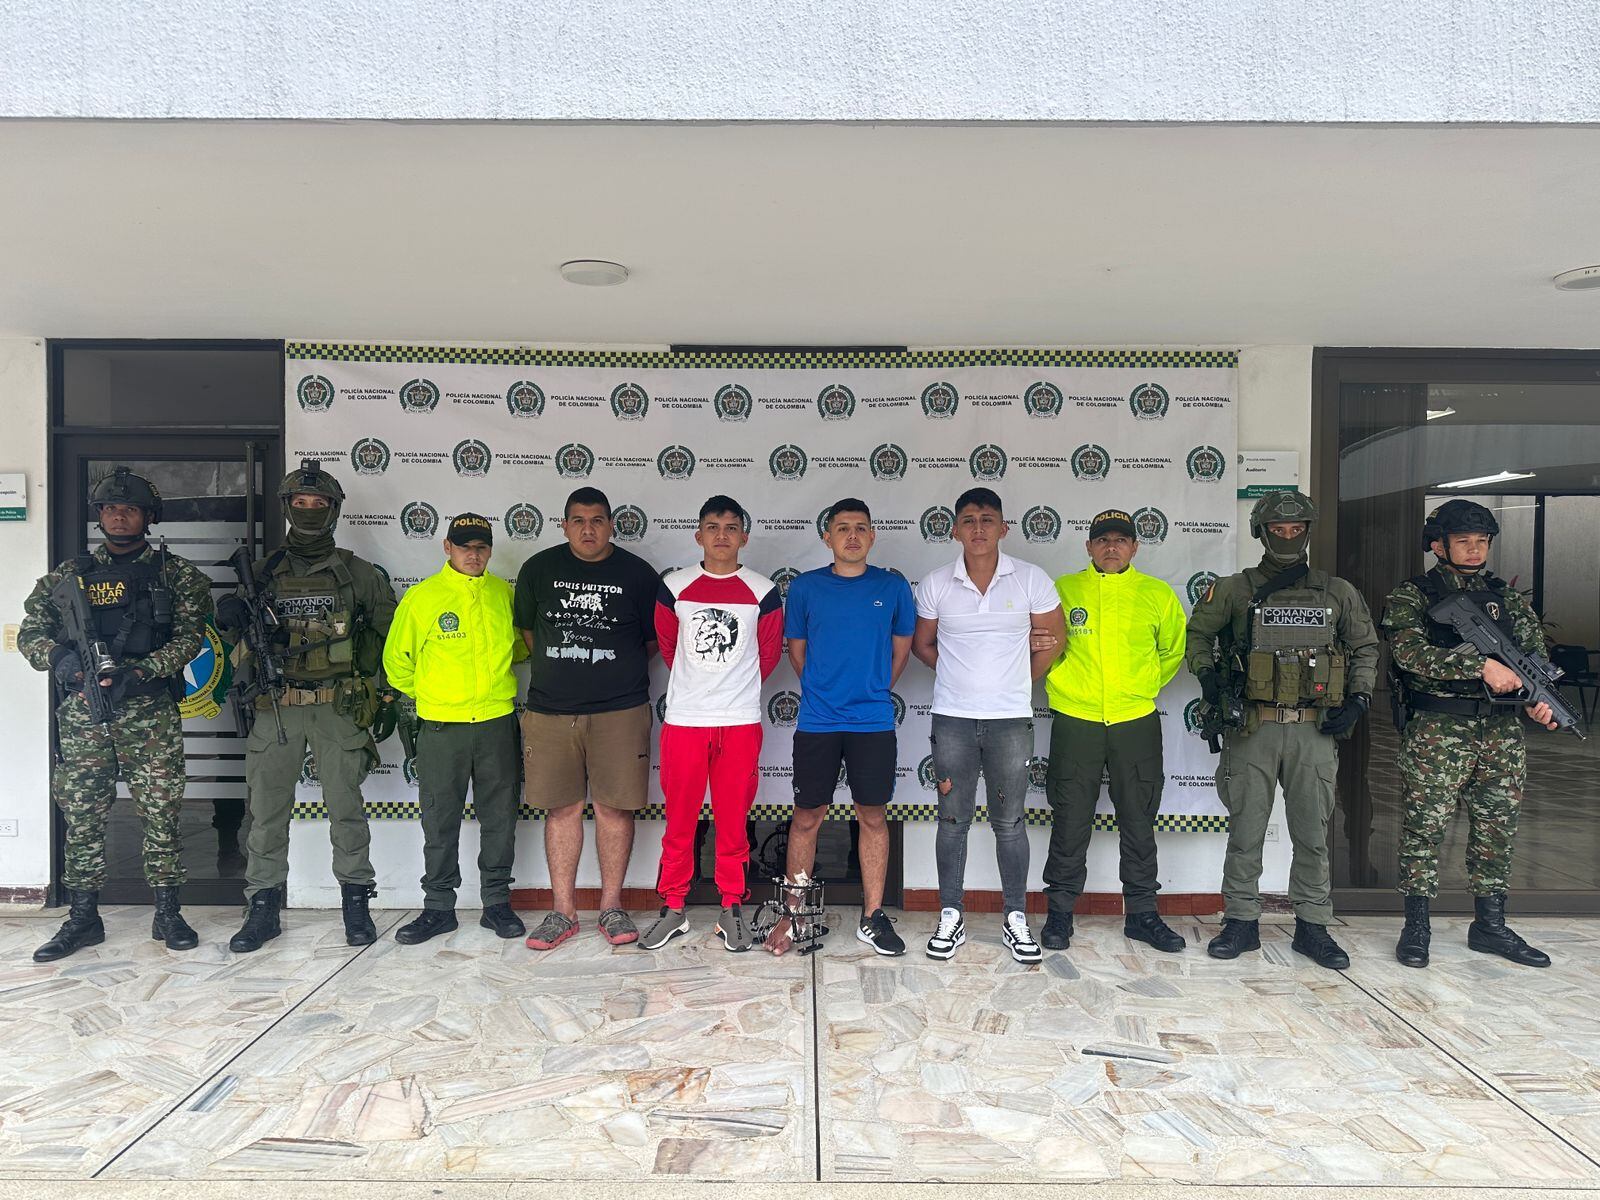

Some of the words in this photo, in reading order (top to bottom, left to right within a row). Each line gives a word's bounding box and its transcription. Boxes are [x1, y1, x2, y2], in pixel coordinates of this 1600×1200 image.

[1094, 512, 1130, 524] POLICIA
[454, 518, 490, 529] POLICIA
[90, 582, 125, 591] AULA
[92, 597, 118, 605] AUCA
[278, 598, 332, 608] COMANDO
[282, 606, 319, 615] JUNGL
[1264, 608, 1323, 617] COMANDO
[1269, 616, 1319, 624] JUNGLA
